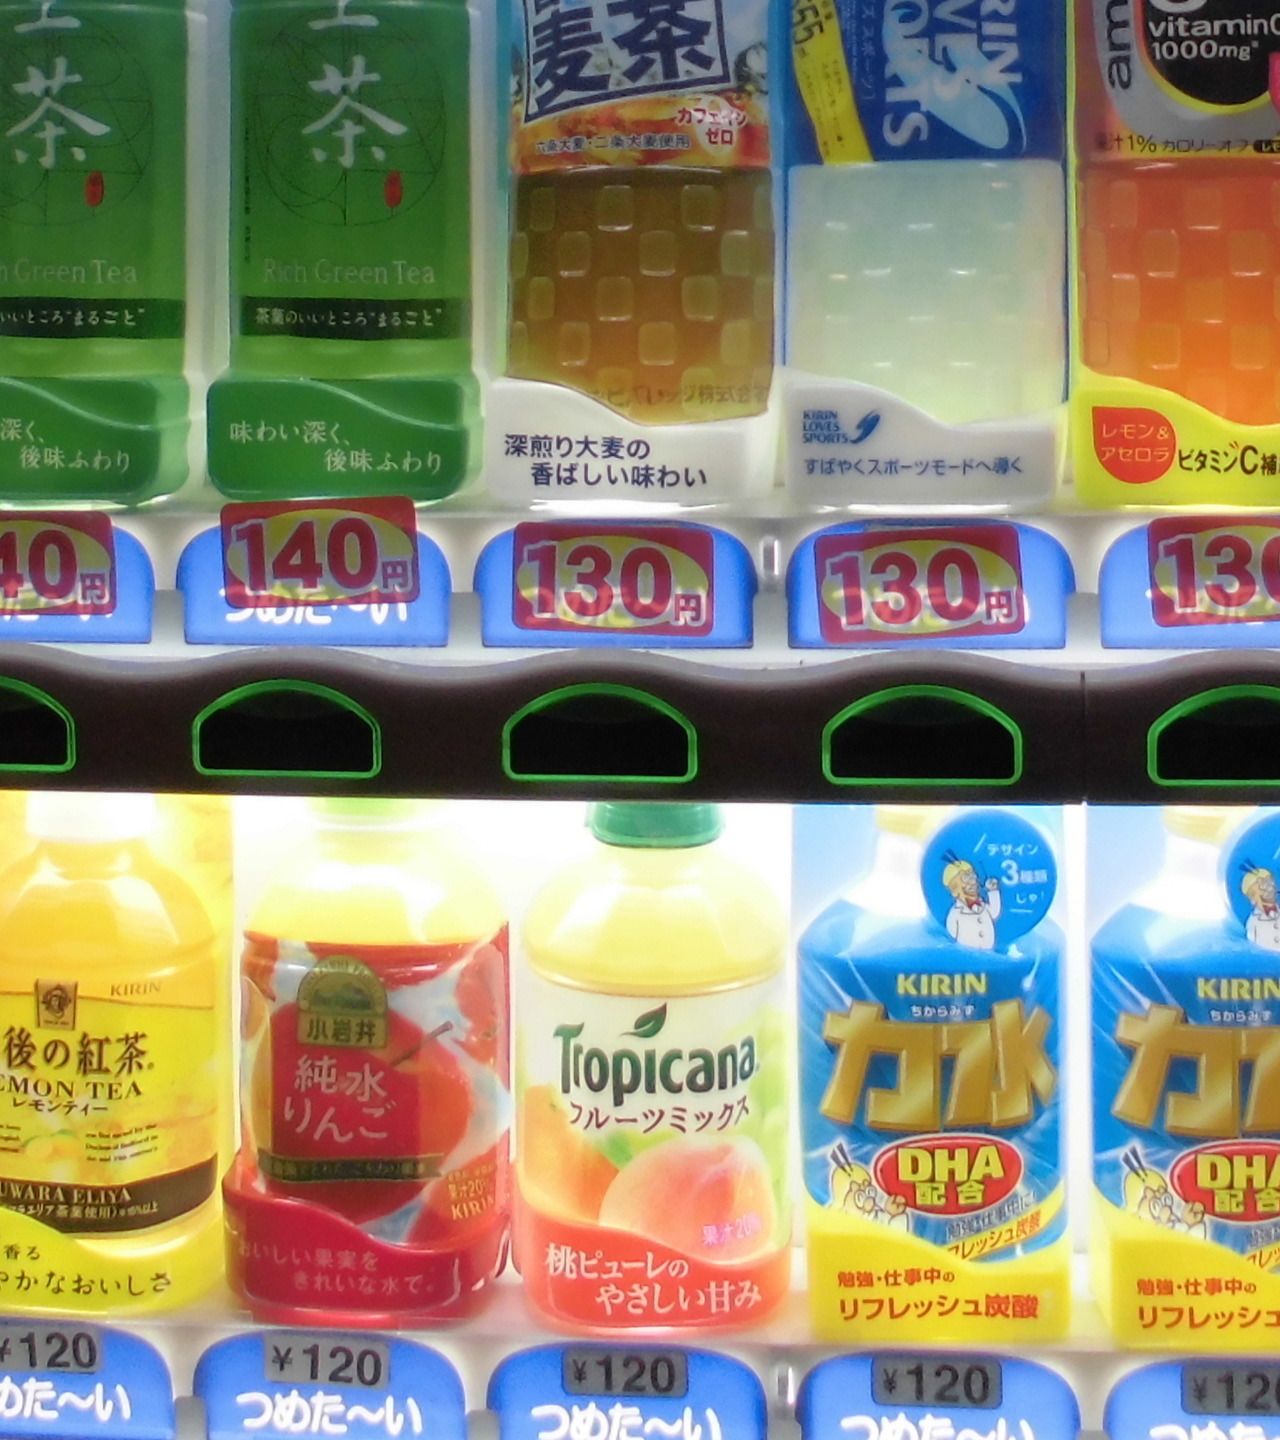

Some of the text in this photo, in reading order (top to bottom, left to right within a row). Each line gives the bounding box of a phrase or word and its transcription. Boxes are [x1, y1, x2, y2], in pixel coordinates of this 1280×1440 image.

[706, 127, 734, 146] ゼロ
[14, 260, 137, 284] Green Tea
[263, 260, 435, 284] Rich Green Tea
[504, 435, 650, 460] 深煎り大麦の
[1102, 446, 1169, 461] アセロラ
[20, 448, 131, 472] 後味ふわり
[325, 450, 441, 474] 後味ふわり
[531, 462, 708, 489] 香ばしい味わい
[234, 519, 412, 591] 140円
[526, 544, 704, 622] 130円
[831, 548, 1015, 628] 130円
[986, 842, 1038, 856] デザイン
[111, 983, 161, 997] KIRIN
[897, 973, 988, 996] KIRIN
[307, 1020, 377, 1042] 小岩井
[553, 1020, 756, 1106] Tropicana
[295, 1055, 387, 1101] 純水
[86, 1081, 142, 1100] TEA
[13, 1097, 108, 1115] レモンティー
[284, 1097, 397, 1141] りんご
[569, 1103, 750, 1135] フルーツミックス
[897, 1146, 1006, 1182] DHA
[73, 1187, 131, 1204] ELIYA
[915, 1182, 985, 1205] 配合
[546, 1244, 688, 1280] 桃ピューレの
[838, 1270, 955, 1287] 勉強・仕事中の
[1137, 1279, 1256, 1296] 勉強・仕事中の
[595, 1281, 762, 1314] やさしい甘み
[840, 1294, 1039, 1320] リフレッシュ炭酸
[271, 1346, 382, 1385] ¥120
[573, 1355, 675, 1392] ¥120
[882, 1366, 990, 1403] ¥120
